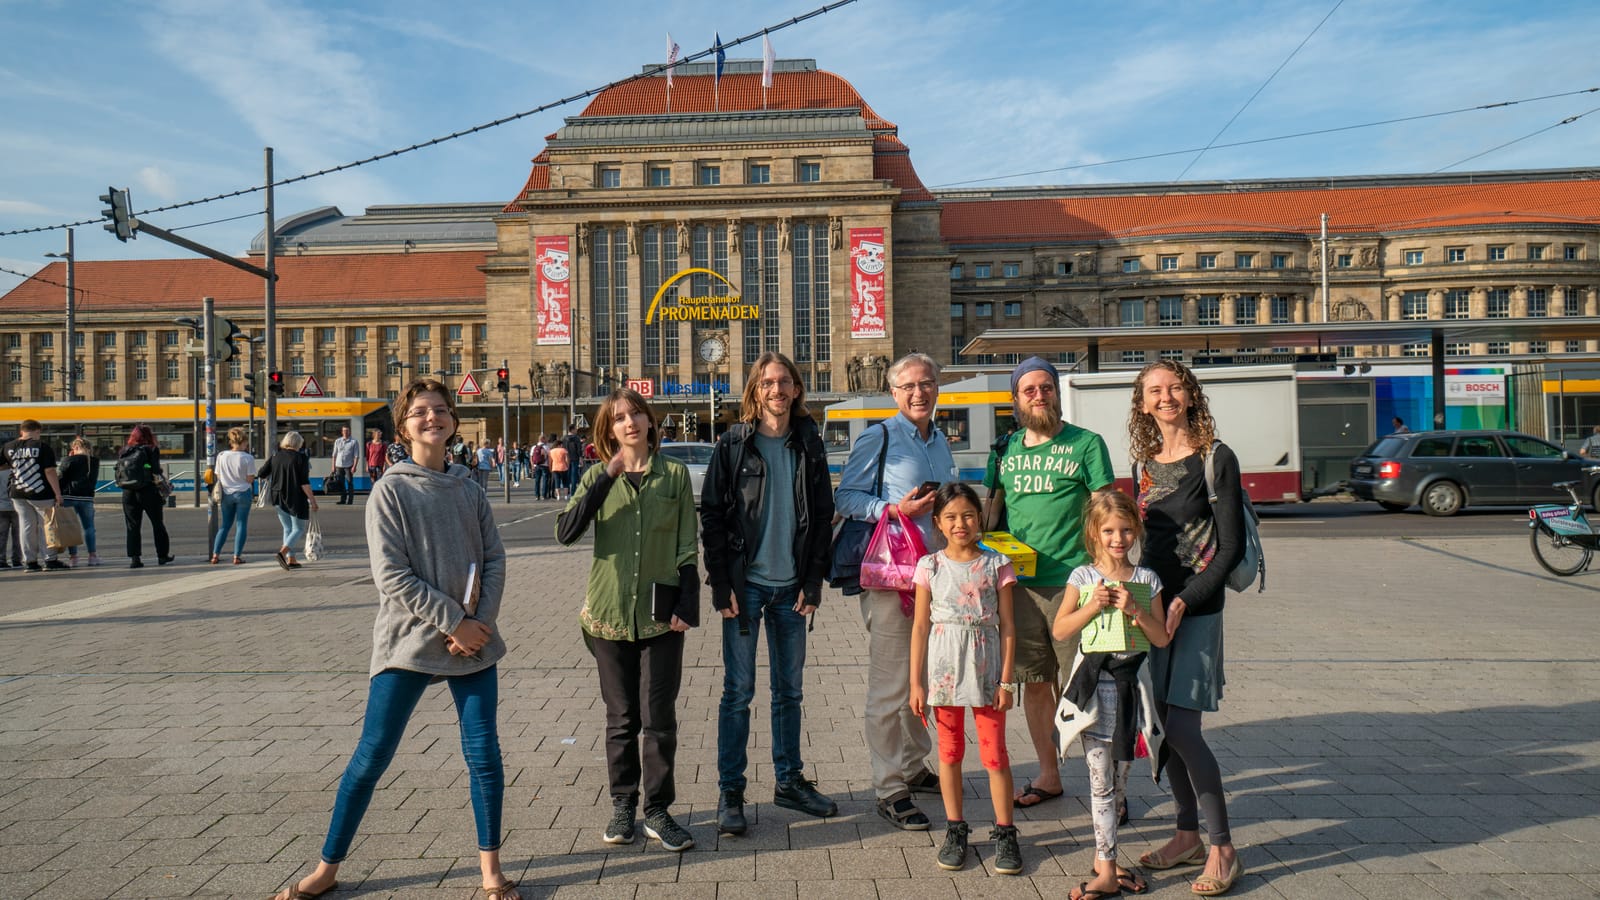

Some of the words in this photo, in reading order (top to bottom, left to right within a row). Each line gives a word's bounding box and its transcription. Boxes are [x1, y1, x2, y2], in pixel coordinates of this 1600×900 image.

[680, 295, 741, 305] Hauptbahnhof
[660, 305, 759, 320] PROMENADEN
[1233, 354, 1299, 364] HAUPTBAHNHOF
[630, 382, 650, 395] DB
[1465, 384, 1499, 392] BOSCH
[1044, 456, 1079, 477] RAW
[1014, 474, 1054, 493] 5204
